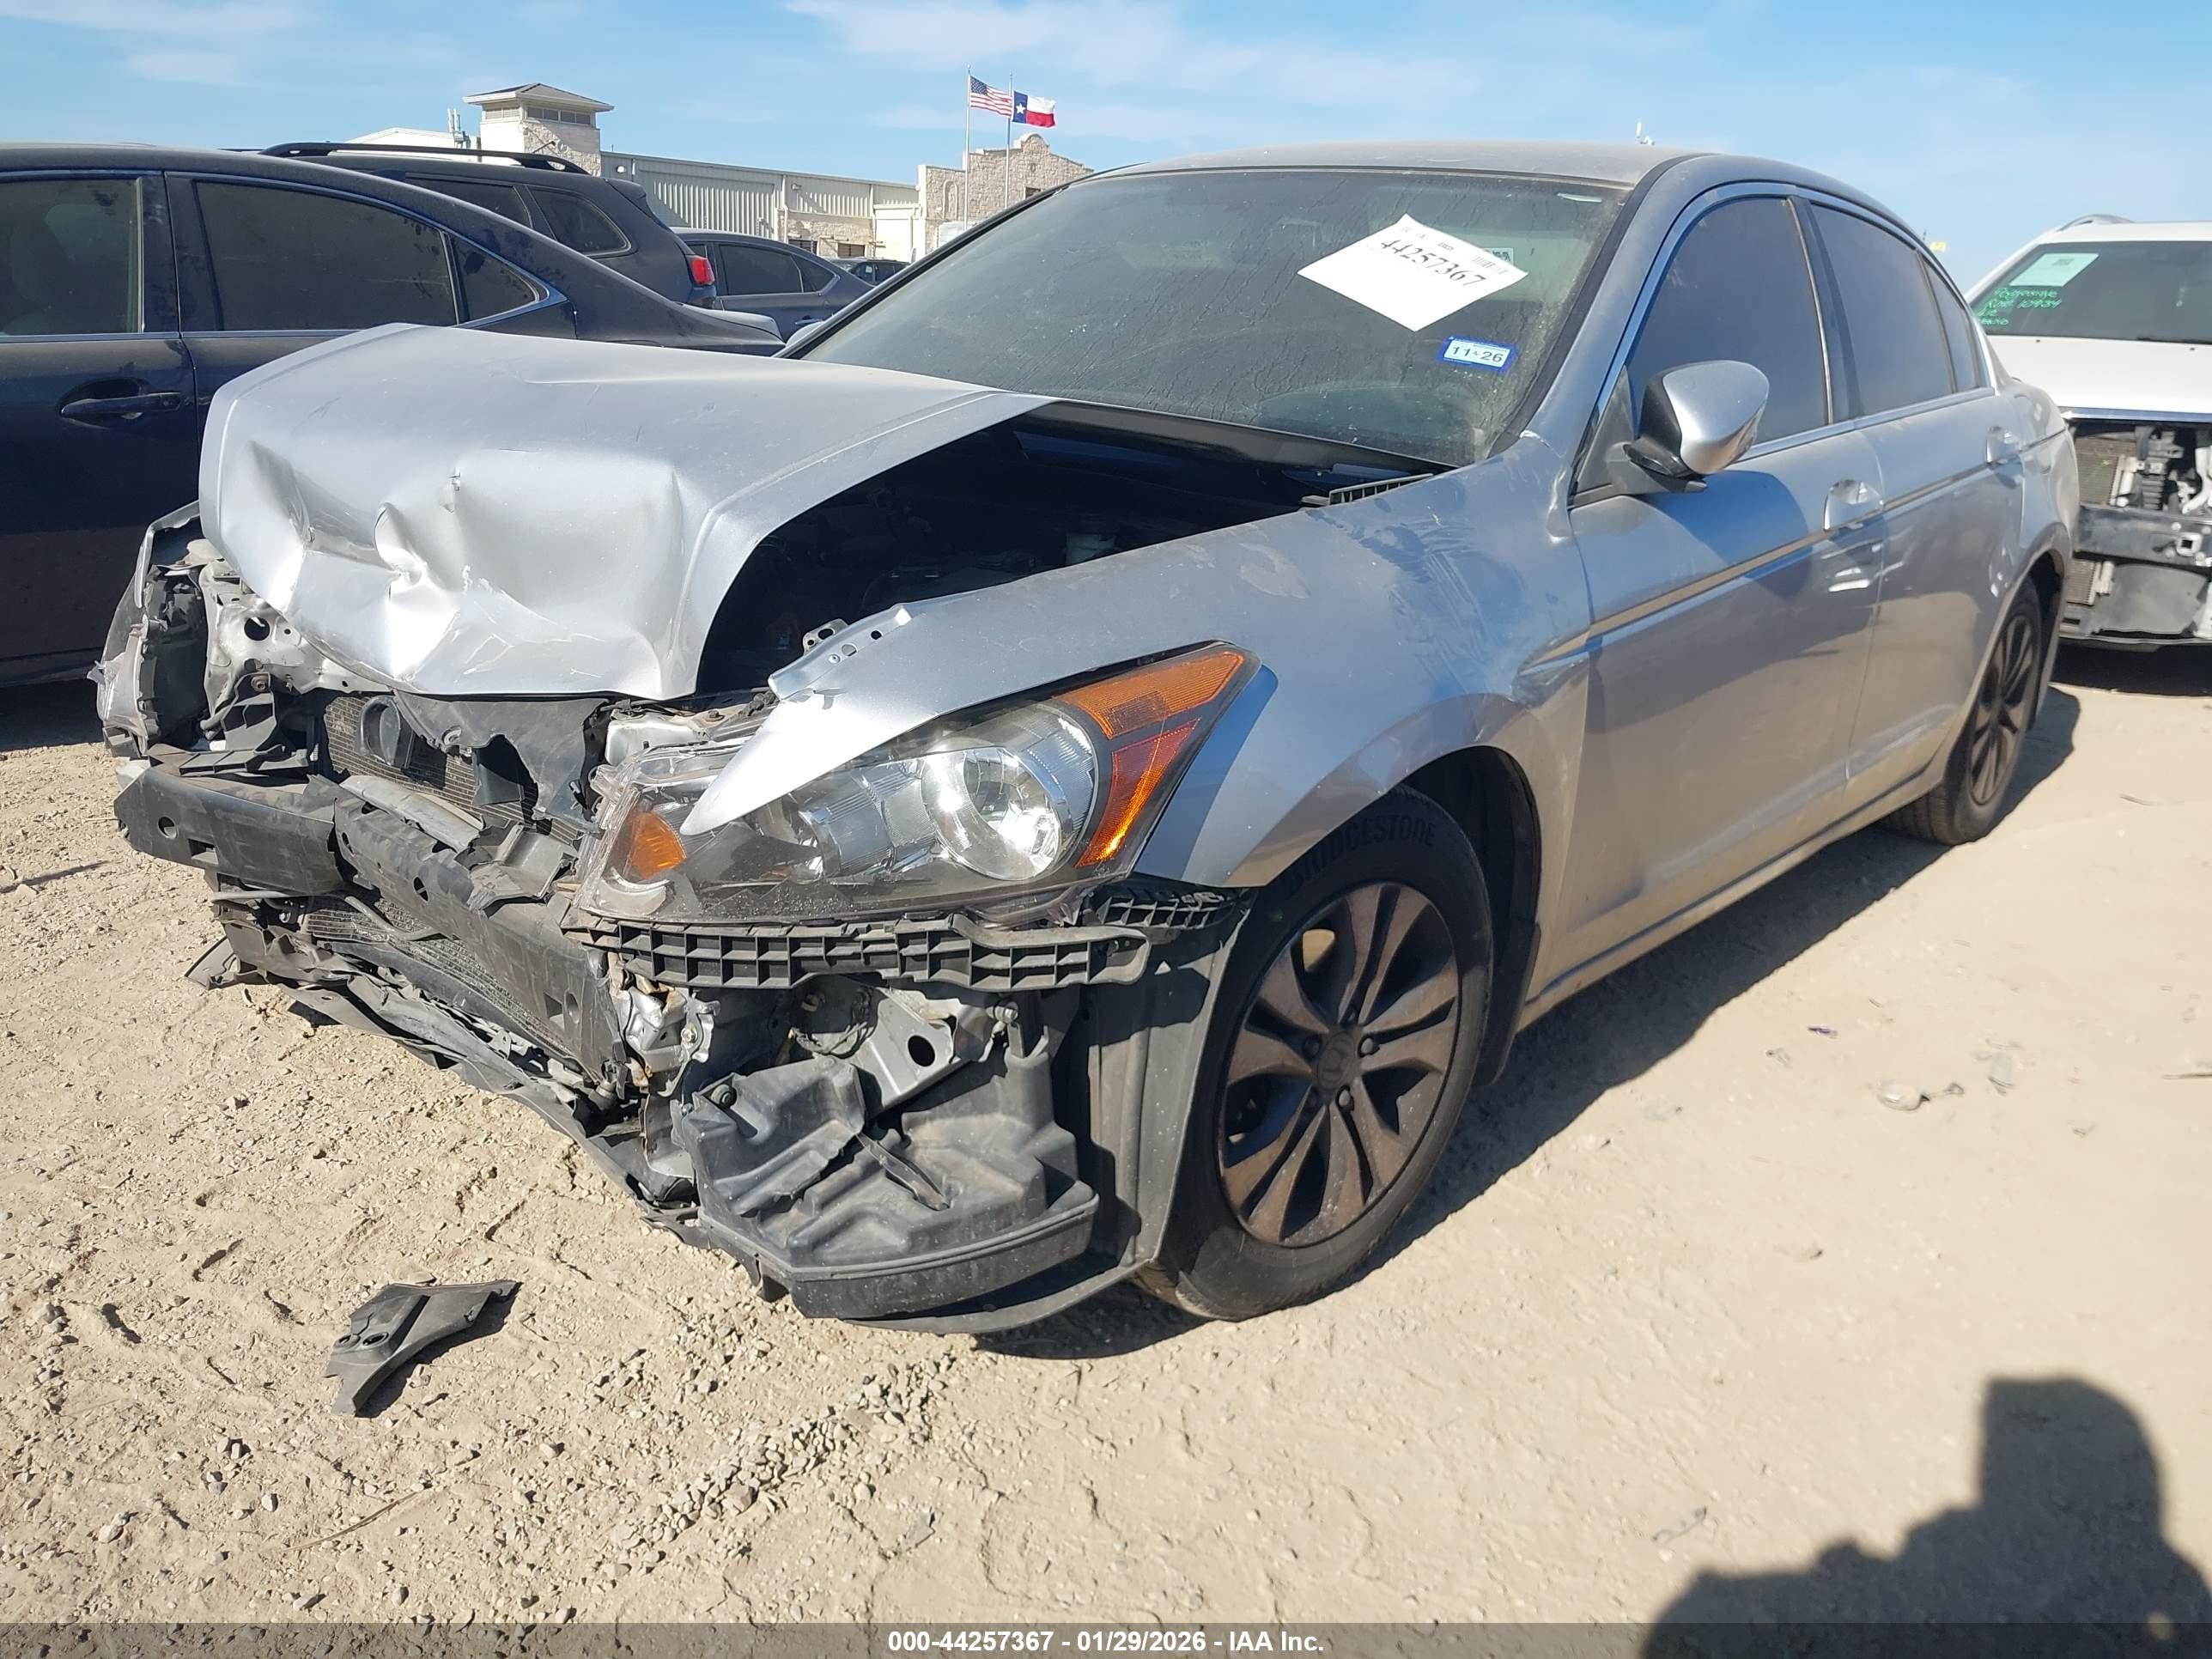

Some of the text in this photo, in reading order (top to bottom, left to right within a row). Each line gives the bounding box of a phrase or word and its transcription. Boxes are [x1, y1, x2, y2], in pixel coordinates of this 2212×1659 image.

[1381, 240, 1486, 286] 44257367
[1452, 345, 1471, 357] 11
[1480, 350, 1504, 363] 26
